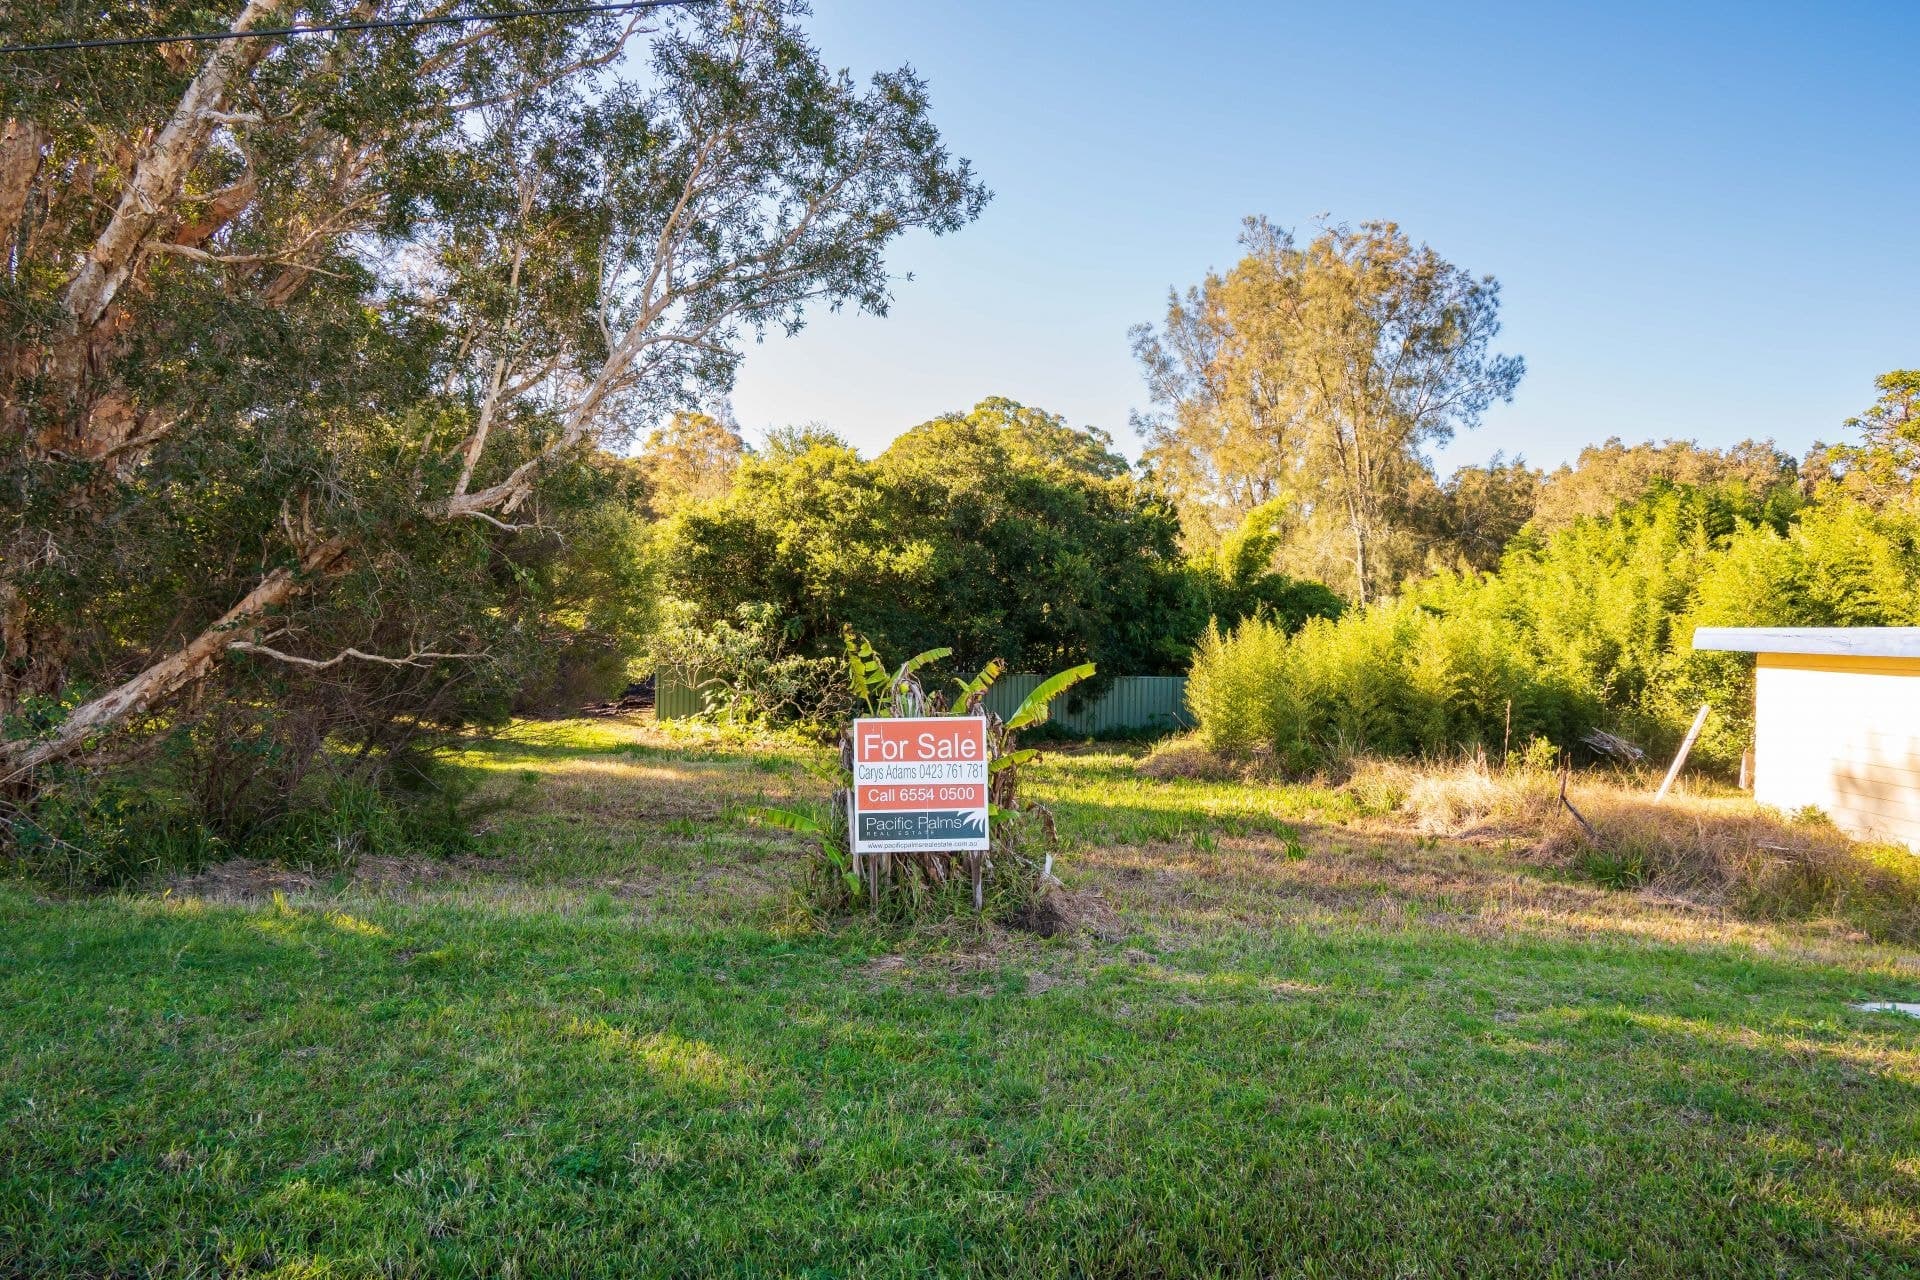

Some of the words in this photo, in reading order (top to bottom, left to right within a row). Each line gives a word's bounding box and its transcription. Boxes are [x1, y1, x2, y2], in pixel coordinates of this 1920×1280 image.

[864, 734, 909, 760] For
[917, 733, 976, 759] Sale
[858, 764, 884, 782] Carys
[885, 764, 917, 780] Adams
[919, 763, 943, 779] 0423
[946, 763, 963, 779] 761
[967, 763, 983, 778] 781
[868, 788, 895, 802] Call
[900, 788, 934, 802] 6554
[939, 787, 975, 800] 0500
[866, 817, 913, 831] Pacific
[918, 816, 962, 830] Palms
